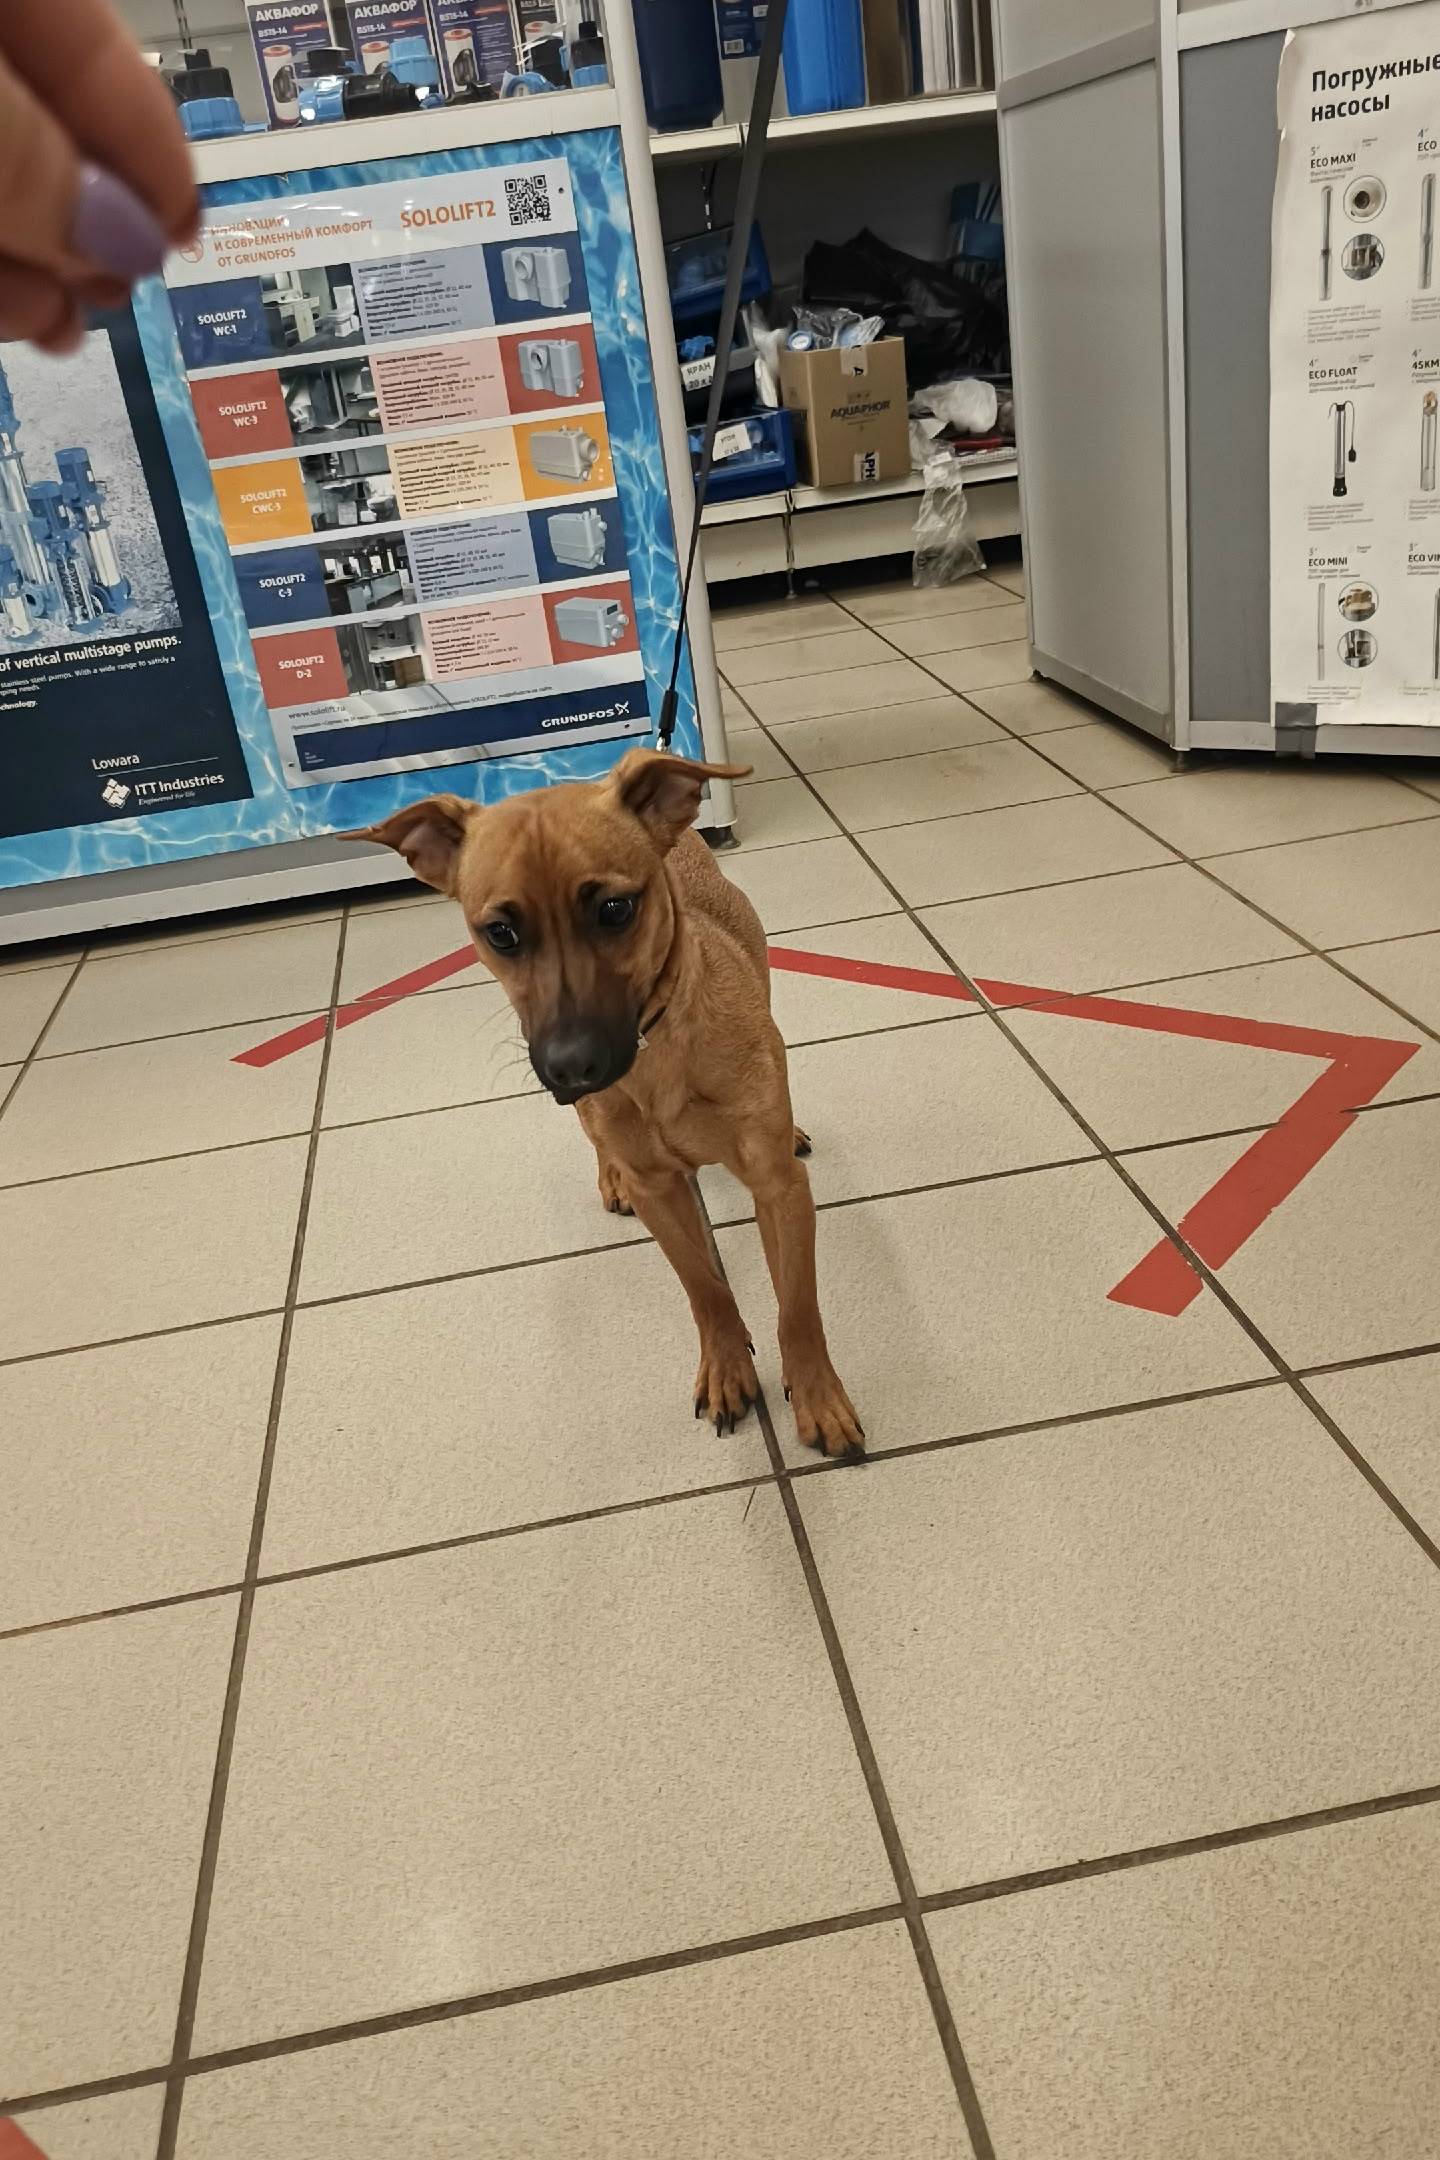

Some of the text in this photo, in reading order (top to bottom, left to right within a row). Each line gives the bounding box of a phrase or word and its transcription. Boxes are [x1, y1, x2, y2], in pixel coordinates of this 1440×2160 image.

[256, 3, 319, 21] АКВАФОР
[355, 0, 417, 19] АКВАФОР
[1311, 94, 1390, 122] насосы
[1417, 140, 1437, 151] ECO
[1310, 153, 1356, 168] ECO MAXI
[400, 200, 497, 228] SOLOLIFT2
[214, 220, 373, 251] И СОВРЕМЕННЫЙ КОМФОРТ
[218, 247, 296, 268] ОТ GRUNDFOS
[198, 309, 247, 325] SOLOLIFT2
[213, 325, 237, 336] WC-1
[1309, 366, 1358, 379] ECO FLOAT
[219, 401, 267, 416] SOLOLIFT2
[831, 400, 891, 419] AQUAPHOR
[234, 416, 258, 427] WC-3
[240, 489, 287, 503] SOLOLIFT2
[252, 502, 281, 514] CWC-3
[1309, 556, 1348, 567] ECO MINI
[1408, 553, 1426, 563] ECO
[259, 573, 306, 588] SOLOLIFT2
[278, 588, 293, 598] C-3
[0, 636, 182, 672] of vertical multistage pumps.
[117, 662, 137, 670] range
[278, 655, 325, 670] SOLOLIFT2
[296, 669, 312, 679] D-2
[541, 708, 614, 728] GRUNDFOS
[91, 754, 140, 771] Lowara
[134, 774, 225, 796] ITT Industries
